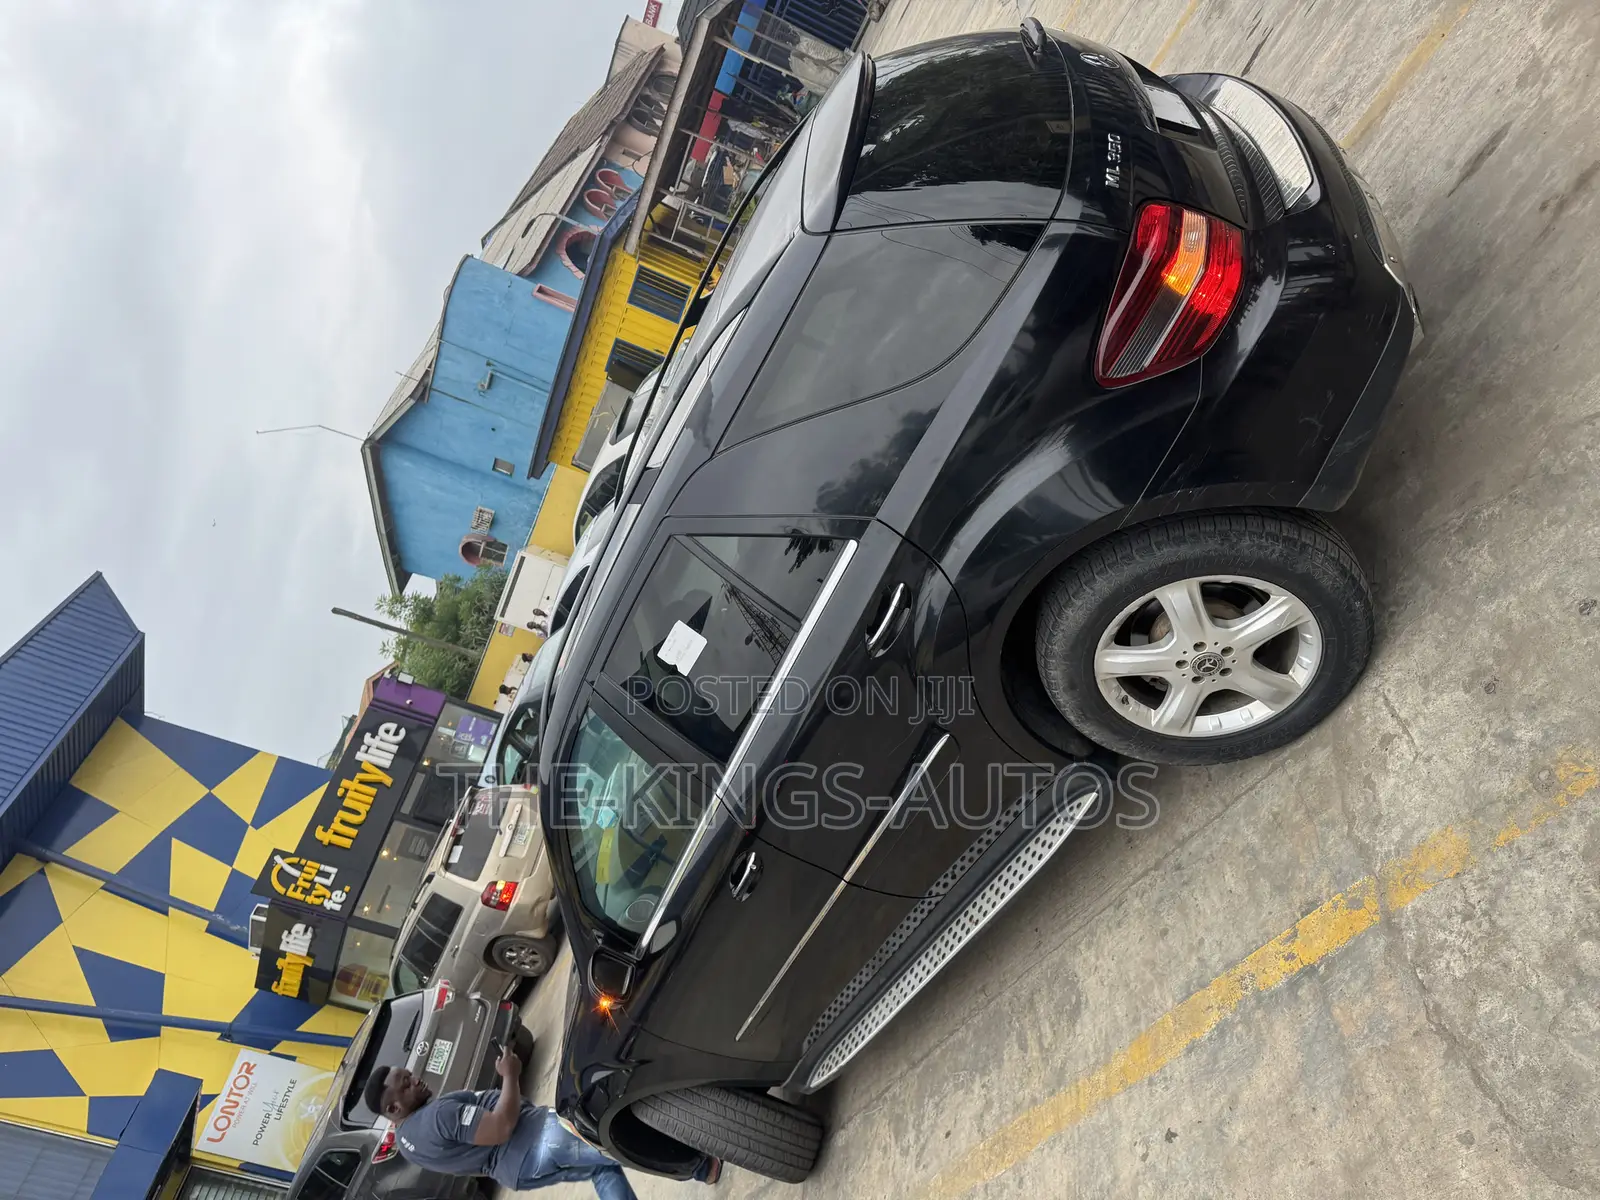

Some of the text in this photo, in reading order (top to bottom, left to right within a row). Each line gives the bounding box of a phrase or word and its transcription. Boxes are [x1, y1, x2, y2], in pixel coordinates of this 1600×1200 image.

[645, 3, 657, 25] BANK
[1105, 133, 1121, 188] ML 350
[315, 722, 406, 849] fruitylife
[271, 923, 314, 998] fruitylife
[207, 1061, 257, 1143] LONTOR
[232, 1104, 246, 1128] POWER
[274, 1079, 297, 1121] LIFESTYLE
[252, 1112, 273, 1146] POWER
